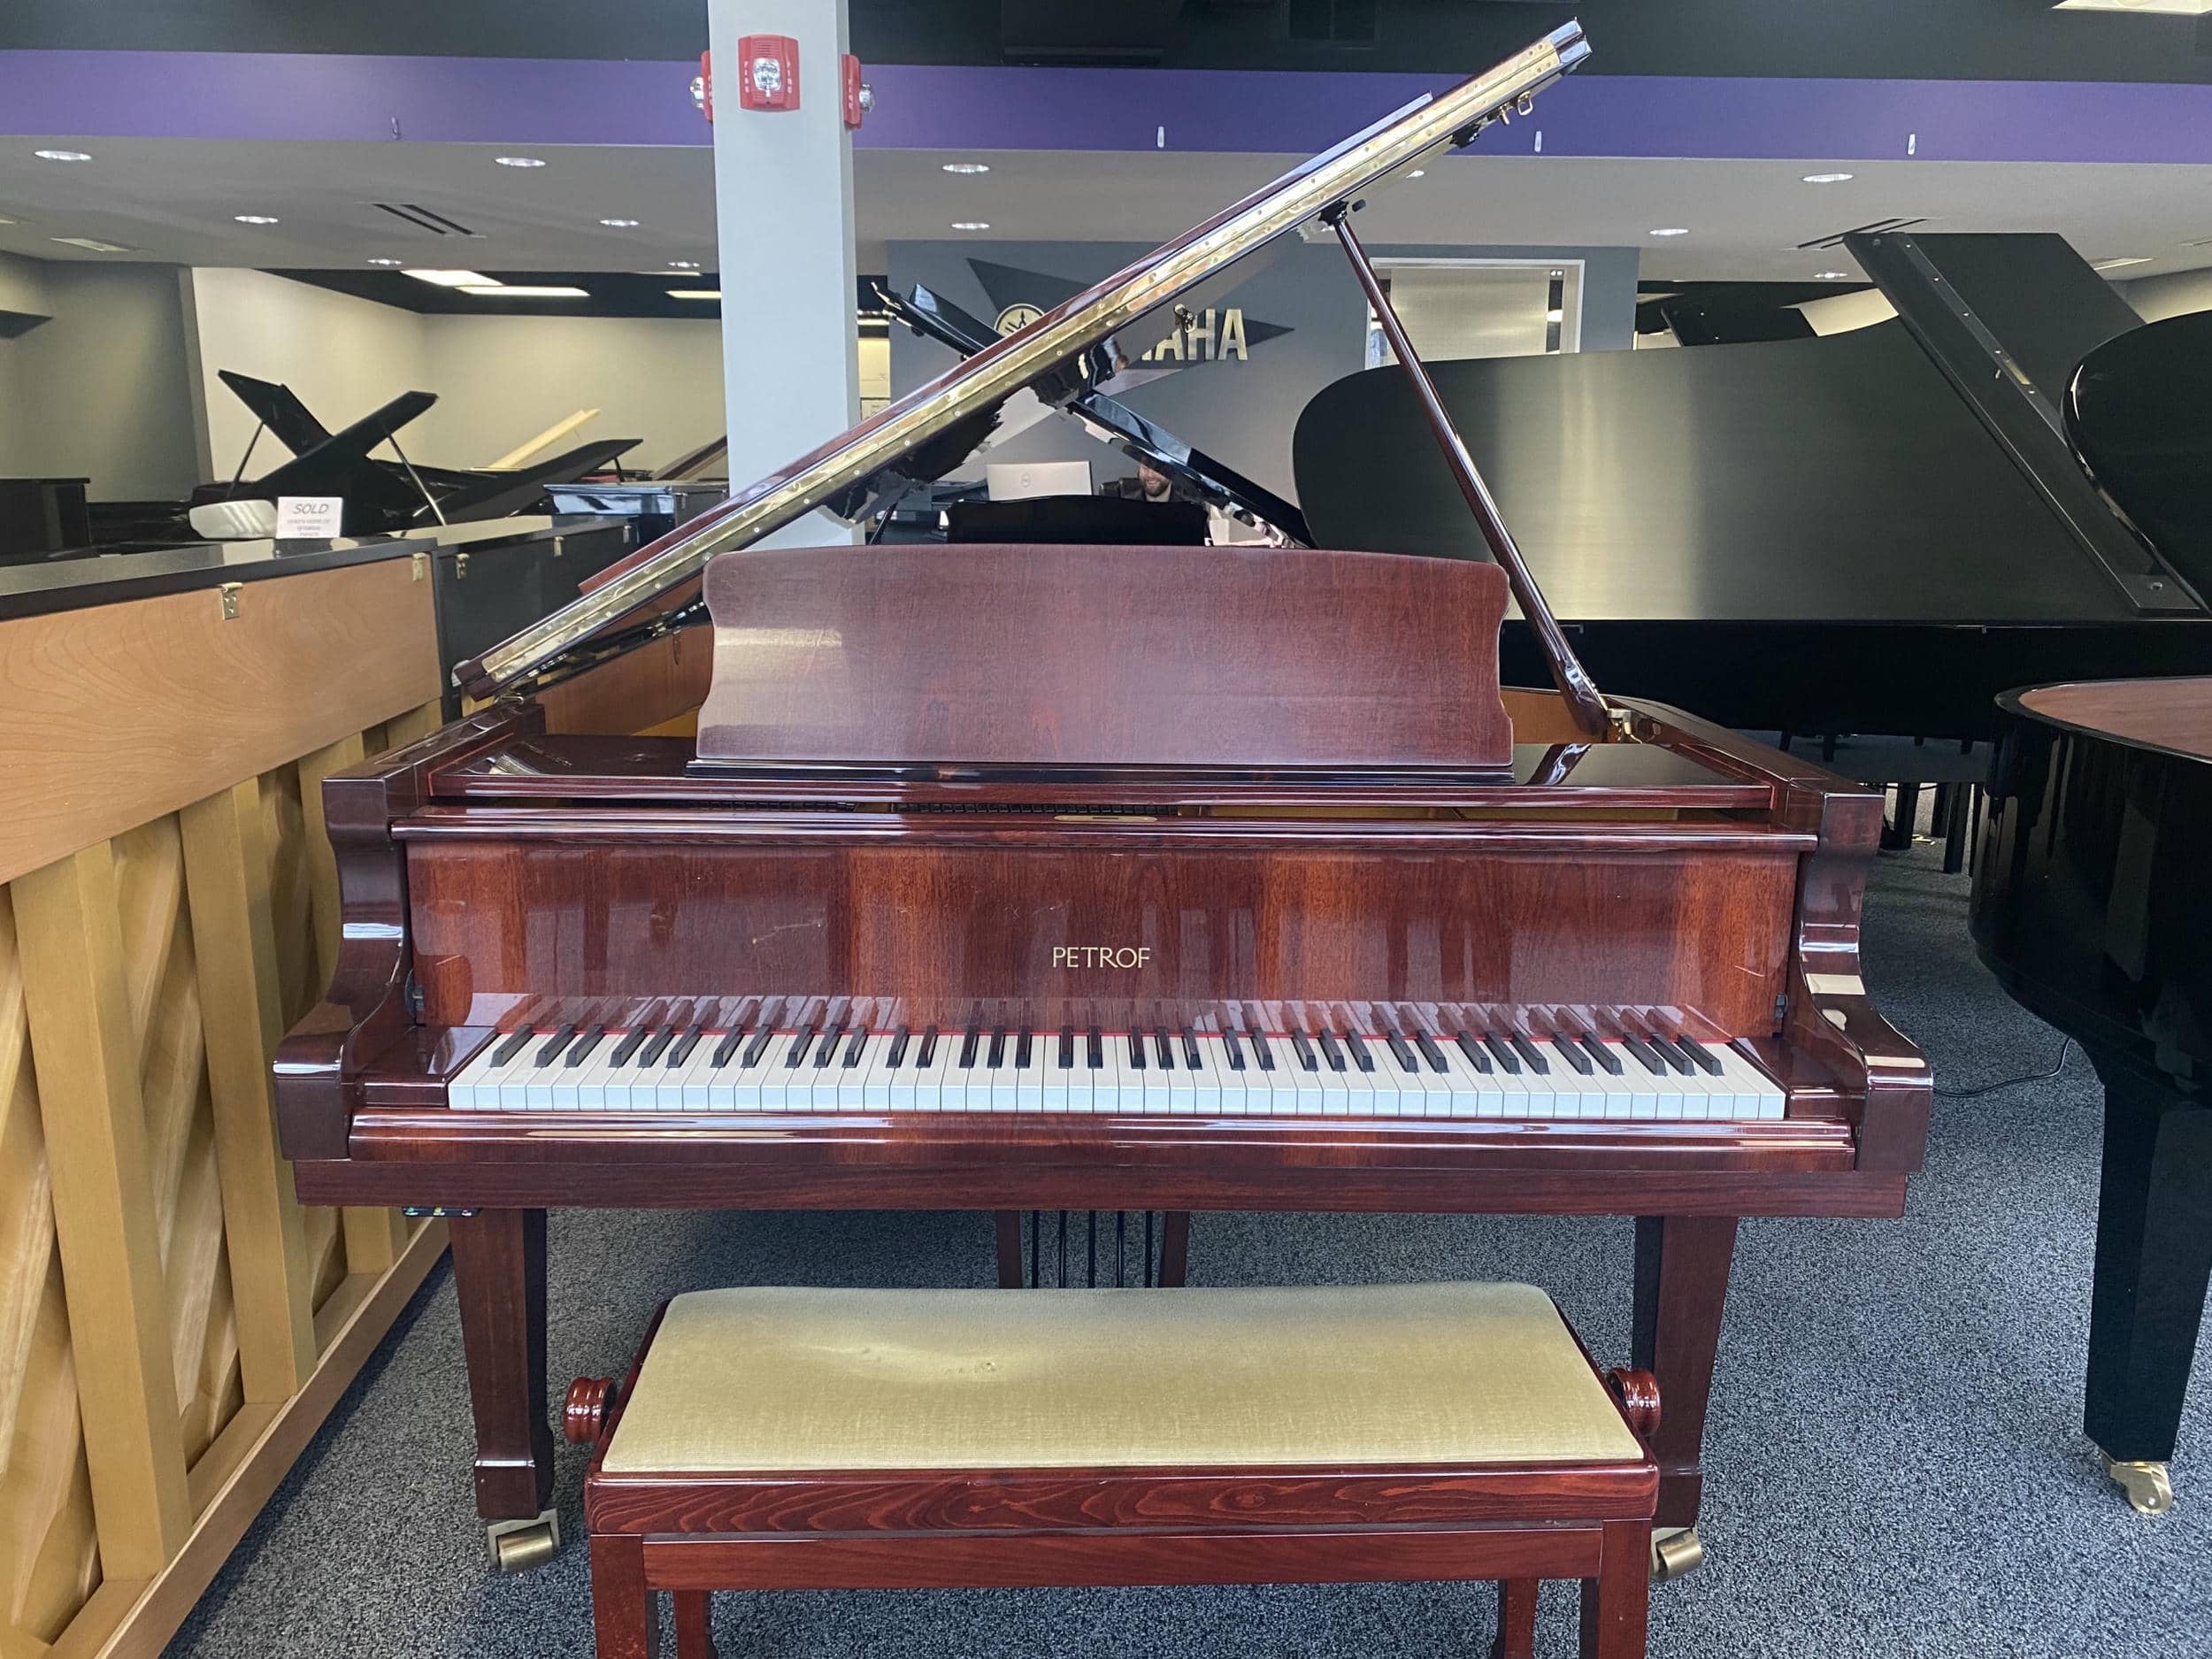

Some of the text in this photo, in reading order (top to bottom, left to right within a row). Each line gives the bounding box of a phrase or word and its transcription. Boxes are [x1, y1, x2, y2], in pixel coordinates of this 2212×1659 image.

[1141, 308, 1248, 360] AHA
[293, 503, 329, 514] SOLD
[1052, 947, 1150, 968] PETROF
